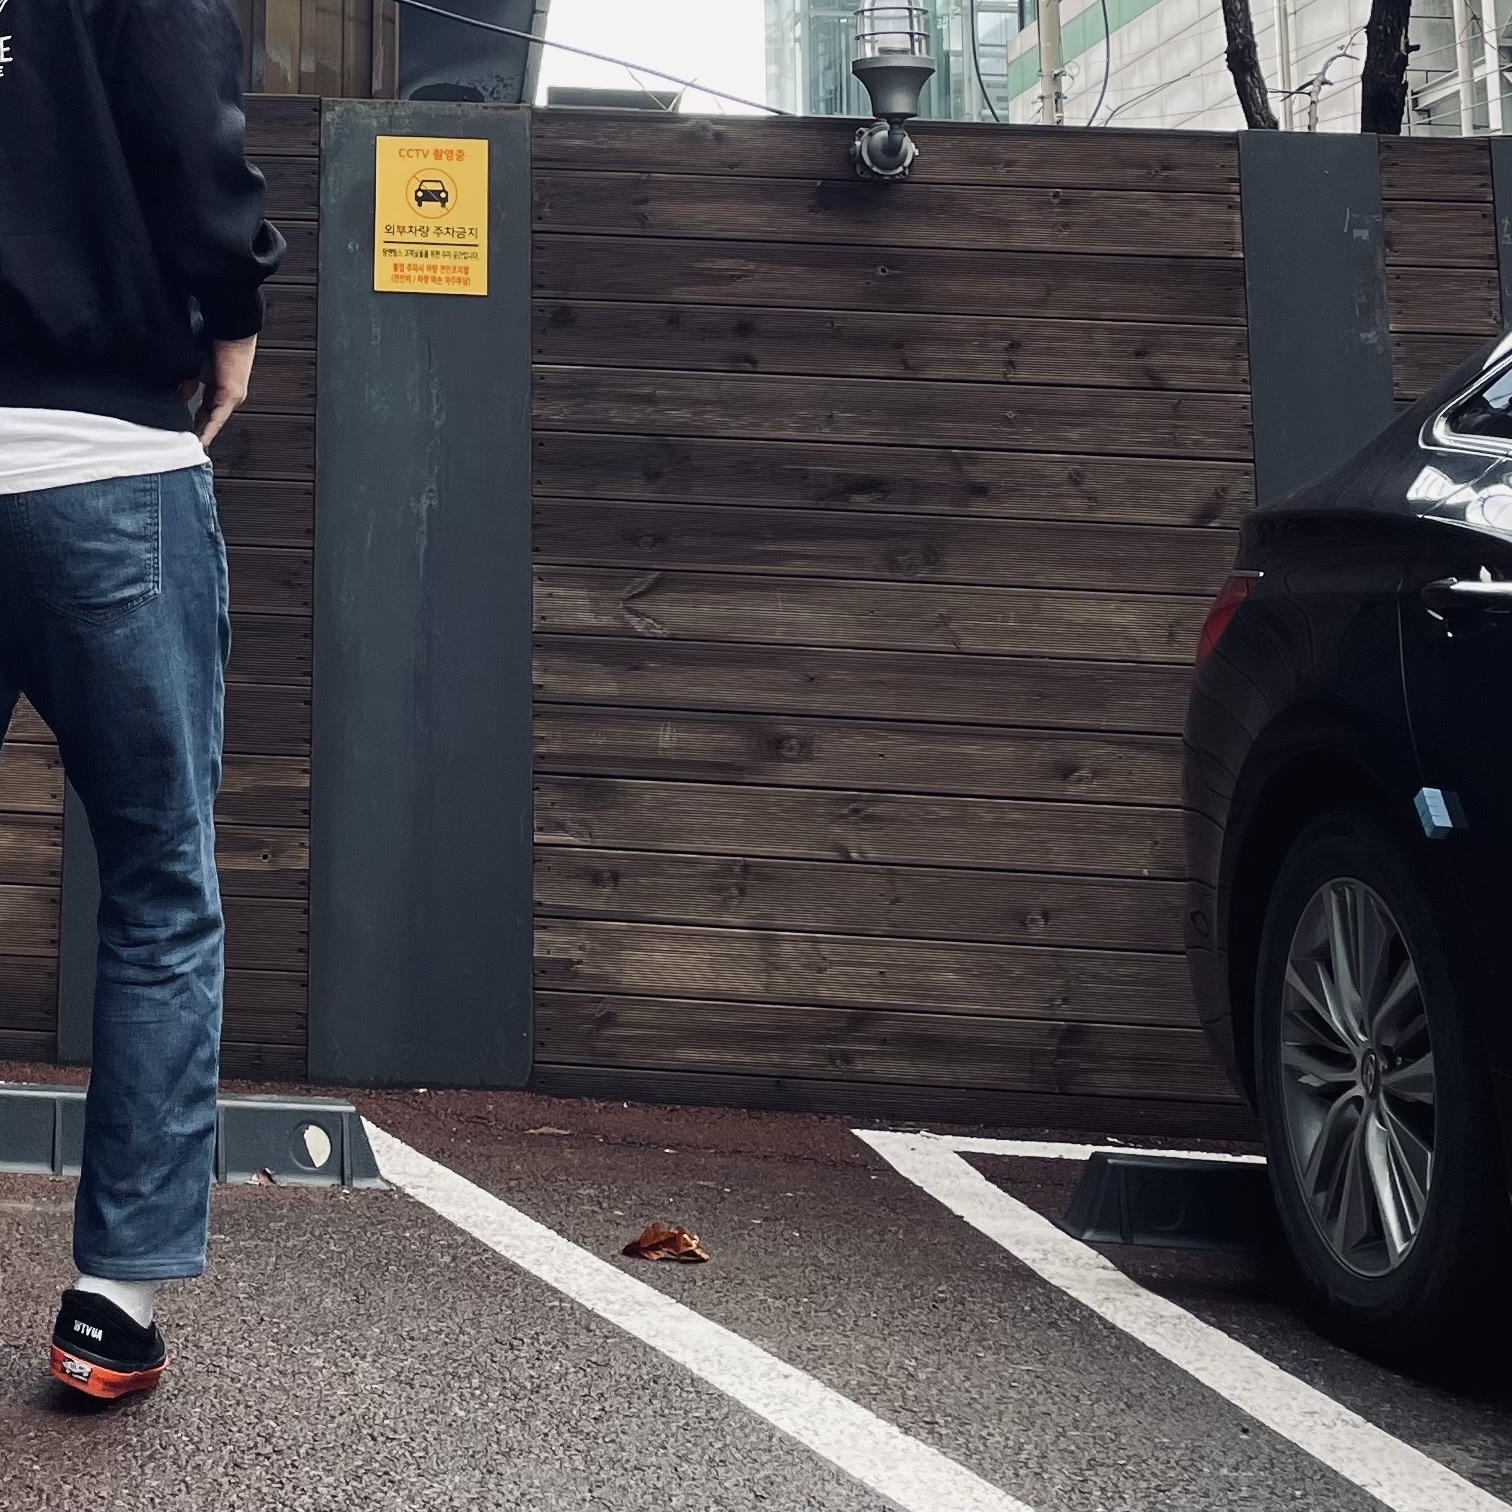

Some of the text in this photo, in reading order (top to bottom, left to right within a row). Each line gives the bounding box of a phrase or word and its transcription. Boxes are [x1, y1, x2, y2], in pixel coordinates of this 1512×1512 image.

[399, 148, 465, 162] CCTV 촬영중
[384, 223, 479, 240] 외부차량 주차금지
